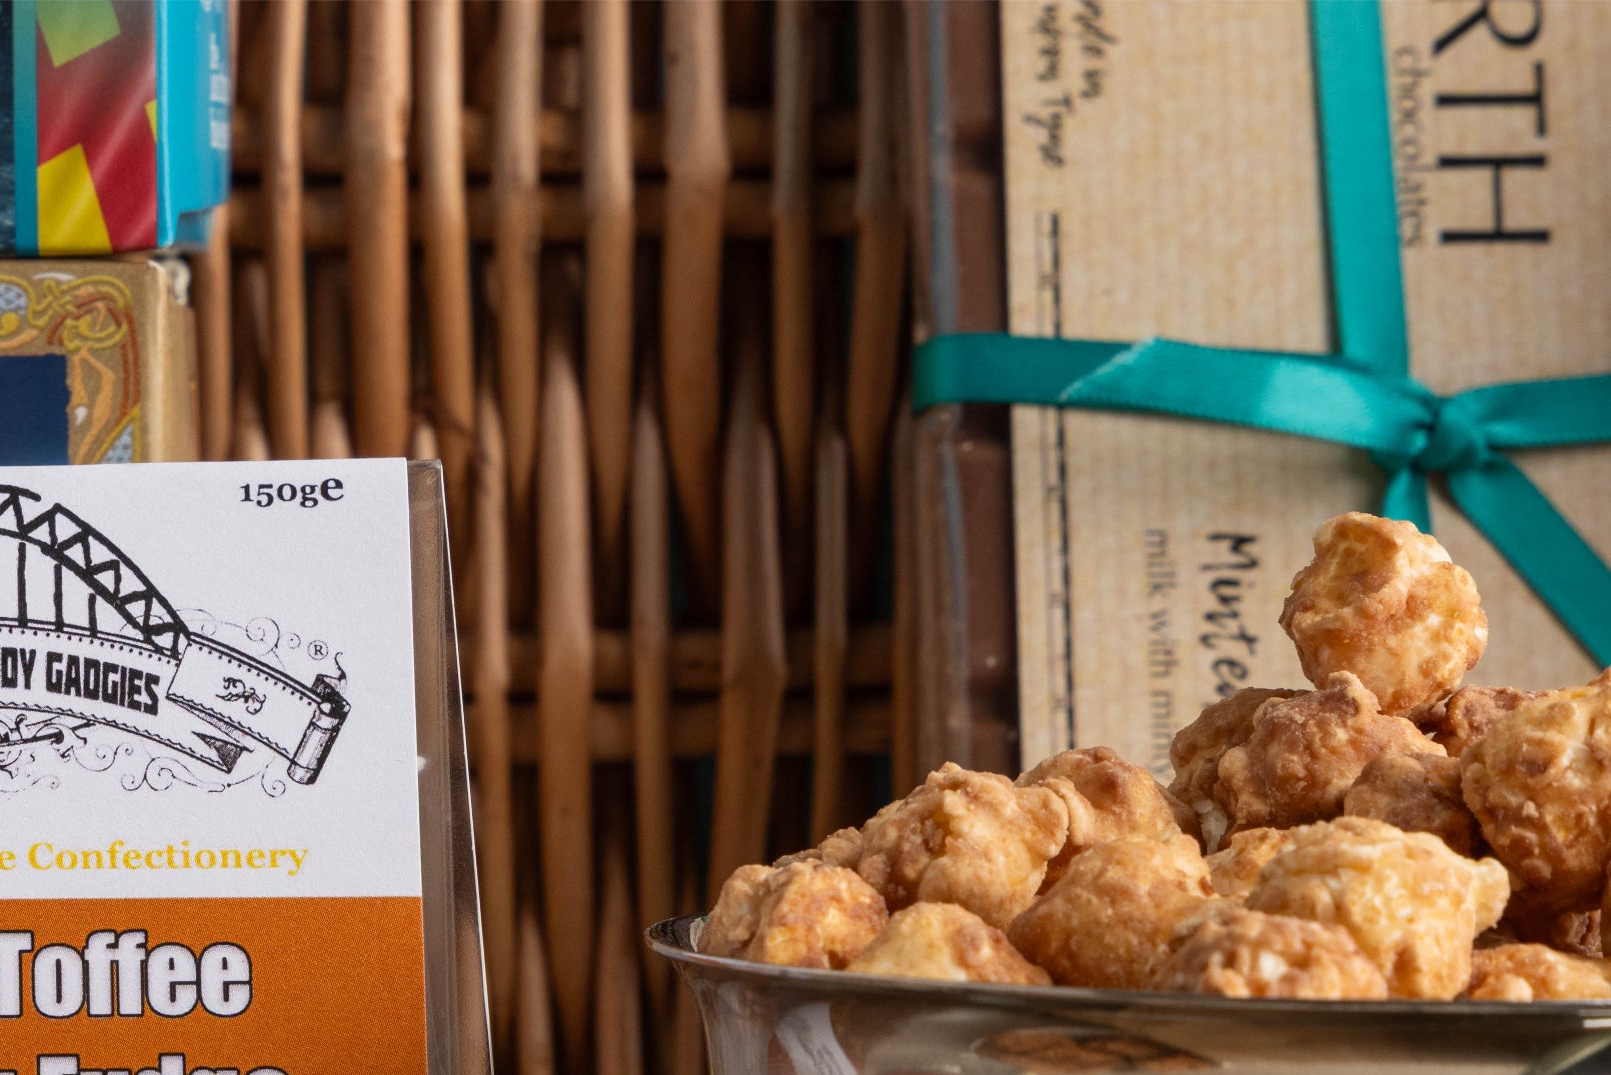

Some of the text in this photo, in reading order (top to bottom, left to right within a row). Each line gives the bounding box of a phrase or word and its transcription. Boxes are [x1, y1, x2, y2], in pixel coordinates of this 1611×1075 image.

[1392, 45, 1435, 249] chocolates
[1433, 0, 1551, 246] RTH
[1144, 528, 1179, 598] milk
[1148, 608, 1181, 679] with
[45, 651, 162, 717] GADGIES
[27, 838, 311, 878] Confectionery
